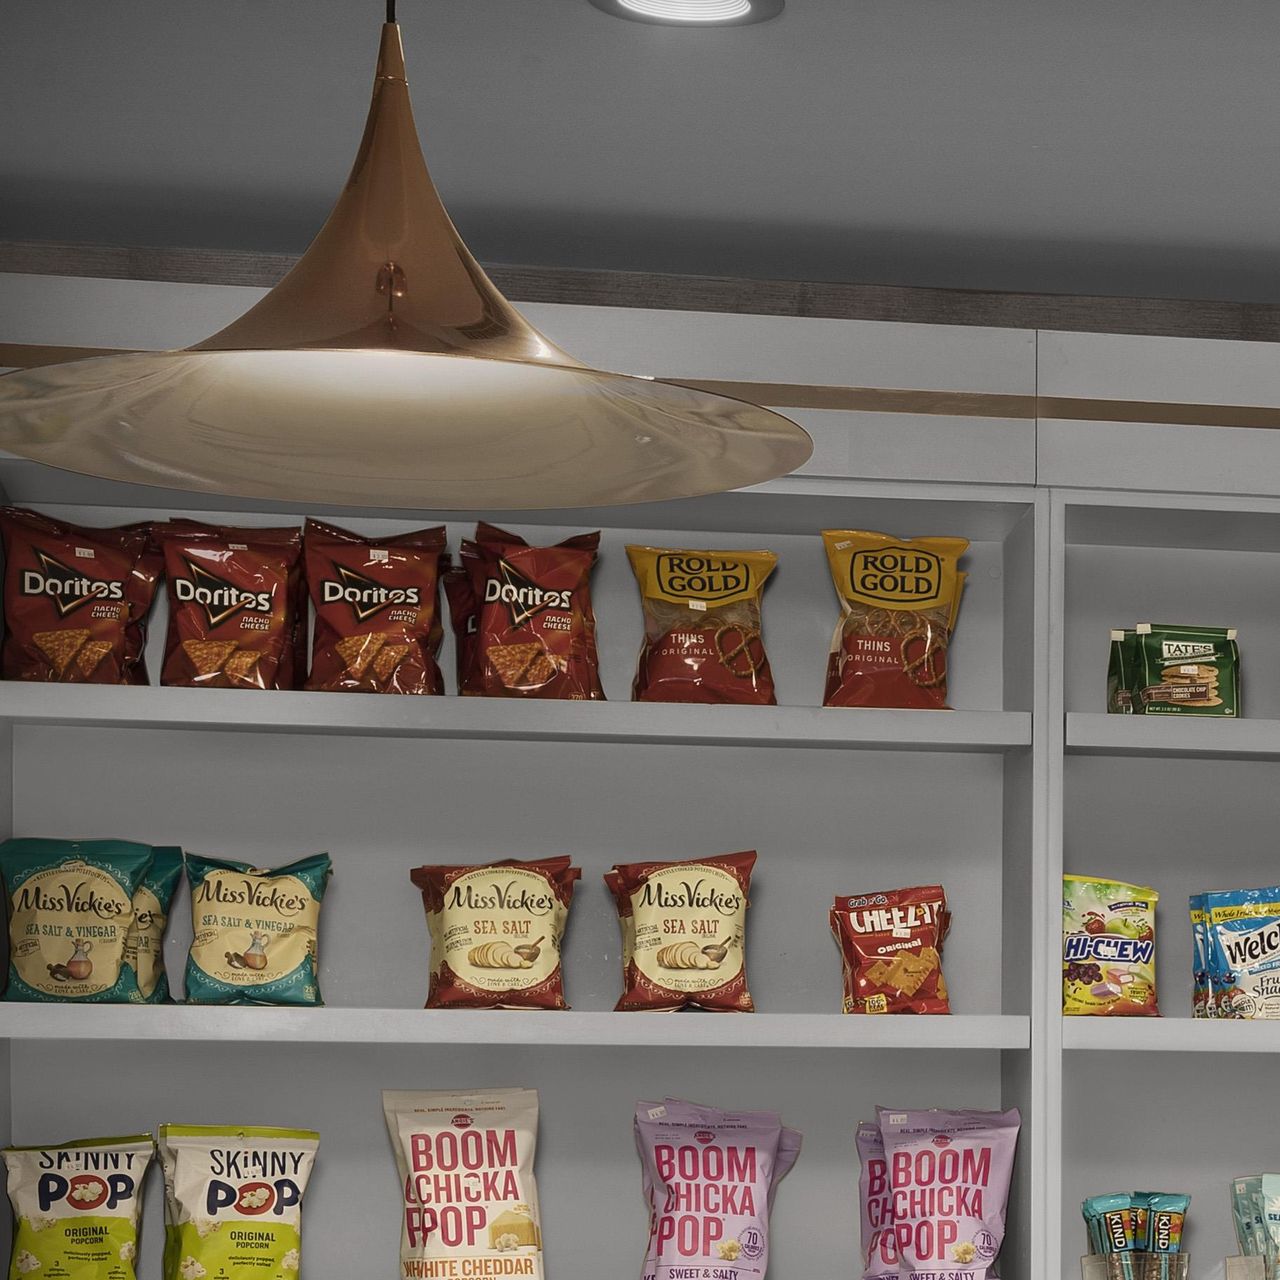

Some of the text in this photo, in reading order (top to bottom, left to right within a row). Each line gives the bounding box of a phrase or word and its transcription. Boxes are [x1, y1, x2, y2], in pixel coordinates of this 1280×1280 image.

[668, 553, 739, 573] ROLD
[862, 547, 933, 573] ROLD
[24, 571, 123, 598] Doritos
[176, 579, 270, 611] Doritos
[324, 581, 418, 604] Doritos
[485, 579, 572, 608] Doritos
[667, 574, 742, 593] GOLD
[860, 572, 933, 594] GOLD
[239, 621, 270, 630] CHEESE
[242, 616, 270, 624] NACHO
[671, 633, 704, 645] THINS
[857, 639, 890, 652] THINS
[1164, 643, 1212, 655] TATE'S
[848, 654, 898, 664] ORIGINAL
[26, 924, 116, 937] SEA SALT & VINEGAR
[202, 915, 294, 932] SEA SALT & VINEGAR
[474, 921, 531, 934] SEA SALT
[411, 1130, 517, 1172] BOOM
[655, 1145, 756, 1183] BOOM
[893, 1148, 991, 1188] BOOM
[38, 1173, 135, 1211] POP
[207, 1179, 301, 1215] POP
[415, 1170, 519, 1203] CHICKA
[664, 1182, 755, 1217] CHICKA
[894, 1186, 983, 1220] CHICKA
[64, 1227, 110, 1237] ORIGINAL
[422, 1206, 487, 1248] POP
[657, 1215, 724, 1257] POP
[1110, 1215, 1127, 1248] KIND
[1158, 1215, 1171, 1249] KIND
[895, 1220, 958, 1261] POP
[462, 1259, 533, 1276] CHEDDAR
[669, 1269, 739, 1280] SWEET & SALTY
